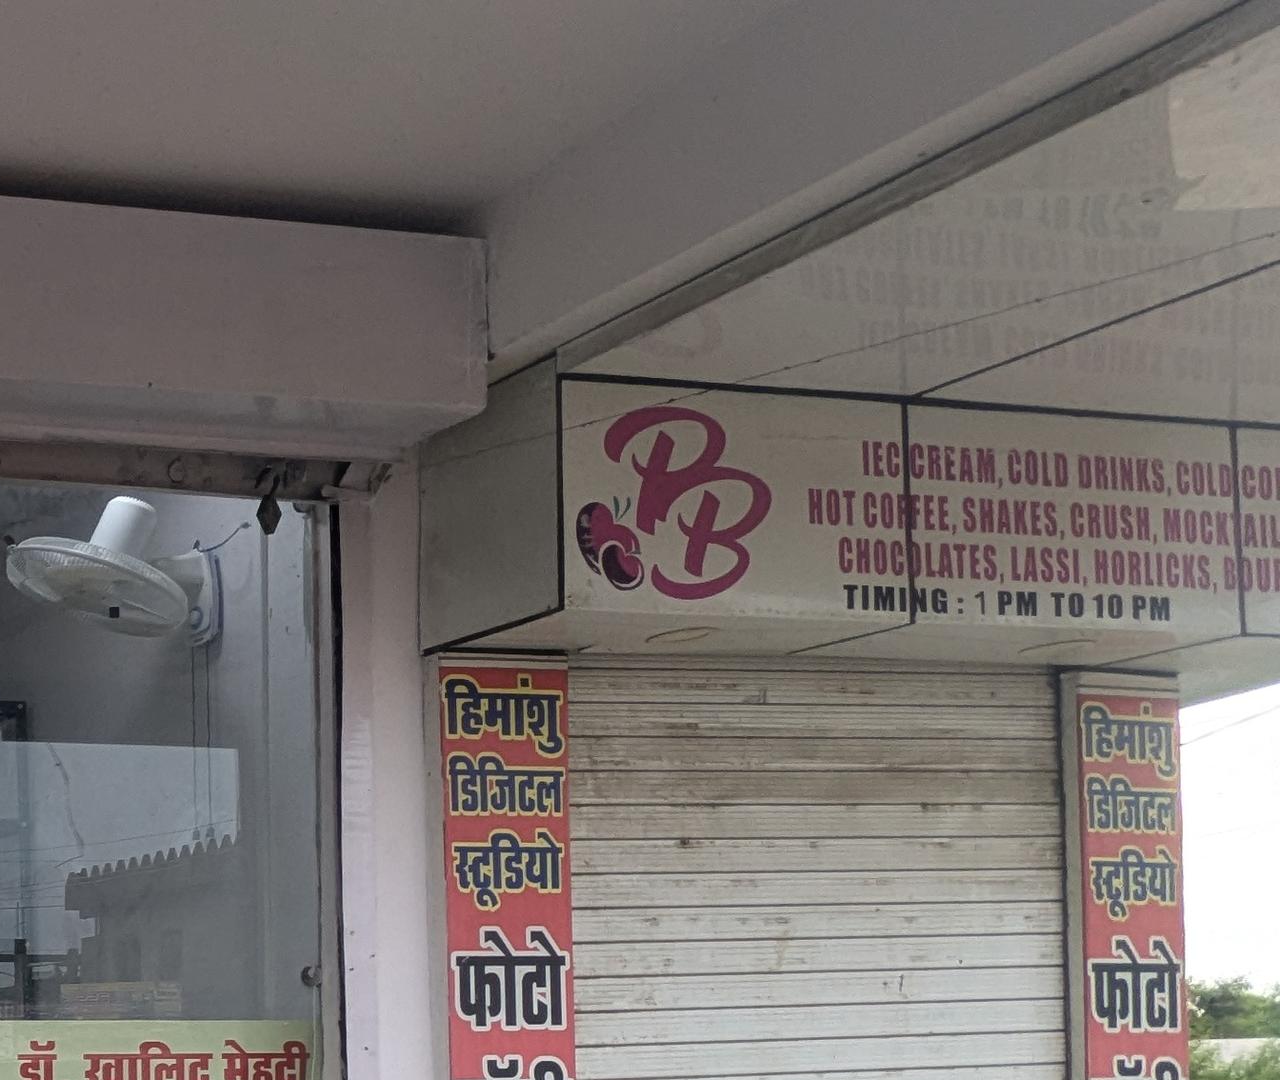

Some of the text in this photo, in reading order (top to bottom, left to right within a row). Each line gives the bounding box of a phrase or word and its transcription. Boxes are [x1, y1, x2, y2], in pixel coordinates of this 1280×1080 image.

[862, 439, 900, 477] IEC
[910, 442, 1003, 489] CREAM,
[1007, 449, 1069, 487] COLD
[1078, 454, 1172, 496] DRINKS,
[1176, 459, 1232, 498] COLD
[808, 488, 856, 526] HOT
[863, 491, 957, 535] COFFEE,
[962, 497, 1065, 540] SHAKES,
[1070, 501, 1158, 545] CRUSH,
[838, 536, 1005, 584] CHOCOLATES,
[1011, 546, 1088, 588] LASSI,
[1094, 549, 1218, 594] HORLICKS,
[842, 584, 1170, 621] TIMING 1 PM TO 10 PM
[444, 676, 563, 756] हिमांशु
[1082, 704, 1175, 776] हिमांशु
[449, 755, 565, 816] डिजिटल
[1086, 777, 1176, 832] डिजिटल
[454, 830, 563, 909] स्टूडियो
[1091, 847, 1176, 916] स्टूडियो
[456, 930, 566, 1028] फोटो
[1091, 939, 1180, 1030] फोटो
